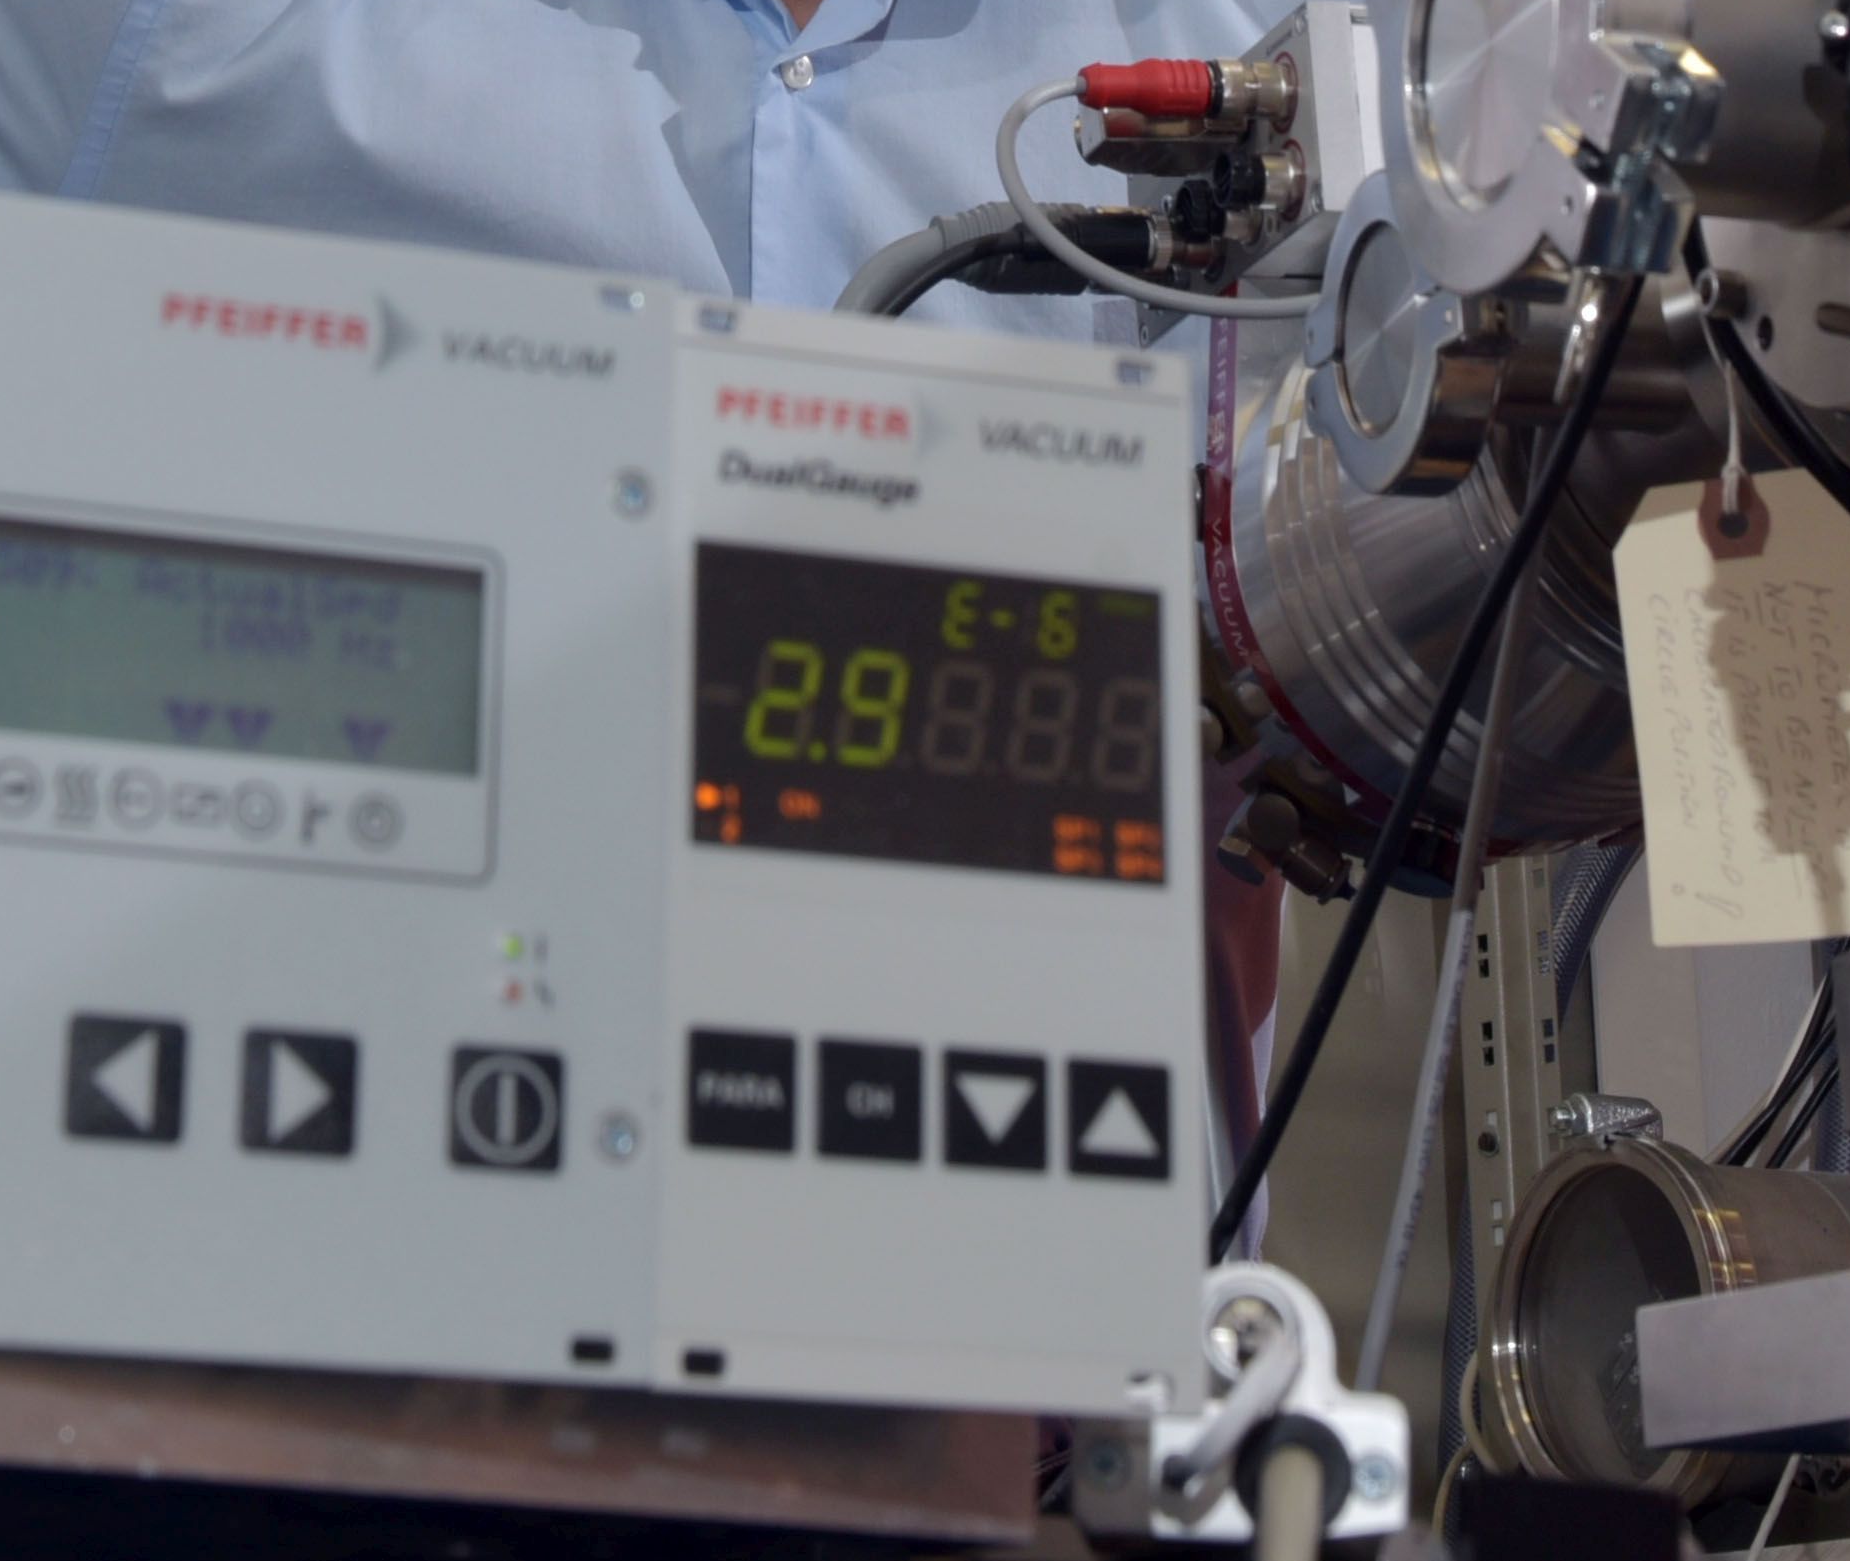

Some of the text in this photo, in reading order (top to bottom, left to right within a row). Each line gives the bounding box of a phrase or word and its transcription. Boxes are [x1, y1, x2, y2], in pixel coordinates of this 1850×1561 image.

[162, 292, 617, 380] PFEIFFER VACUUM
[717, 386, 1145, 468] PFEIFFER VACUUM
[719, 449, 921, 509] DualGauge
[1212, 518, 1248, 659] VACUUM
[1763, 581, 1797, 648] NOT
[697, 1069, 896, 1119] PARA CH
